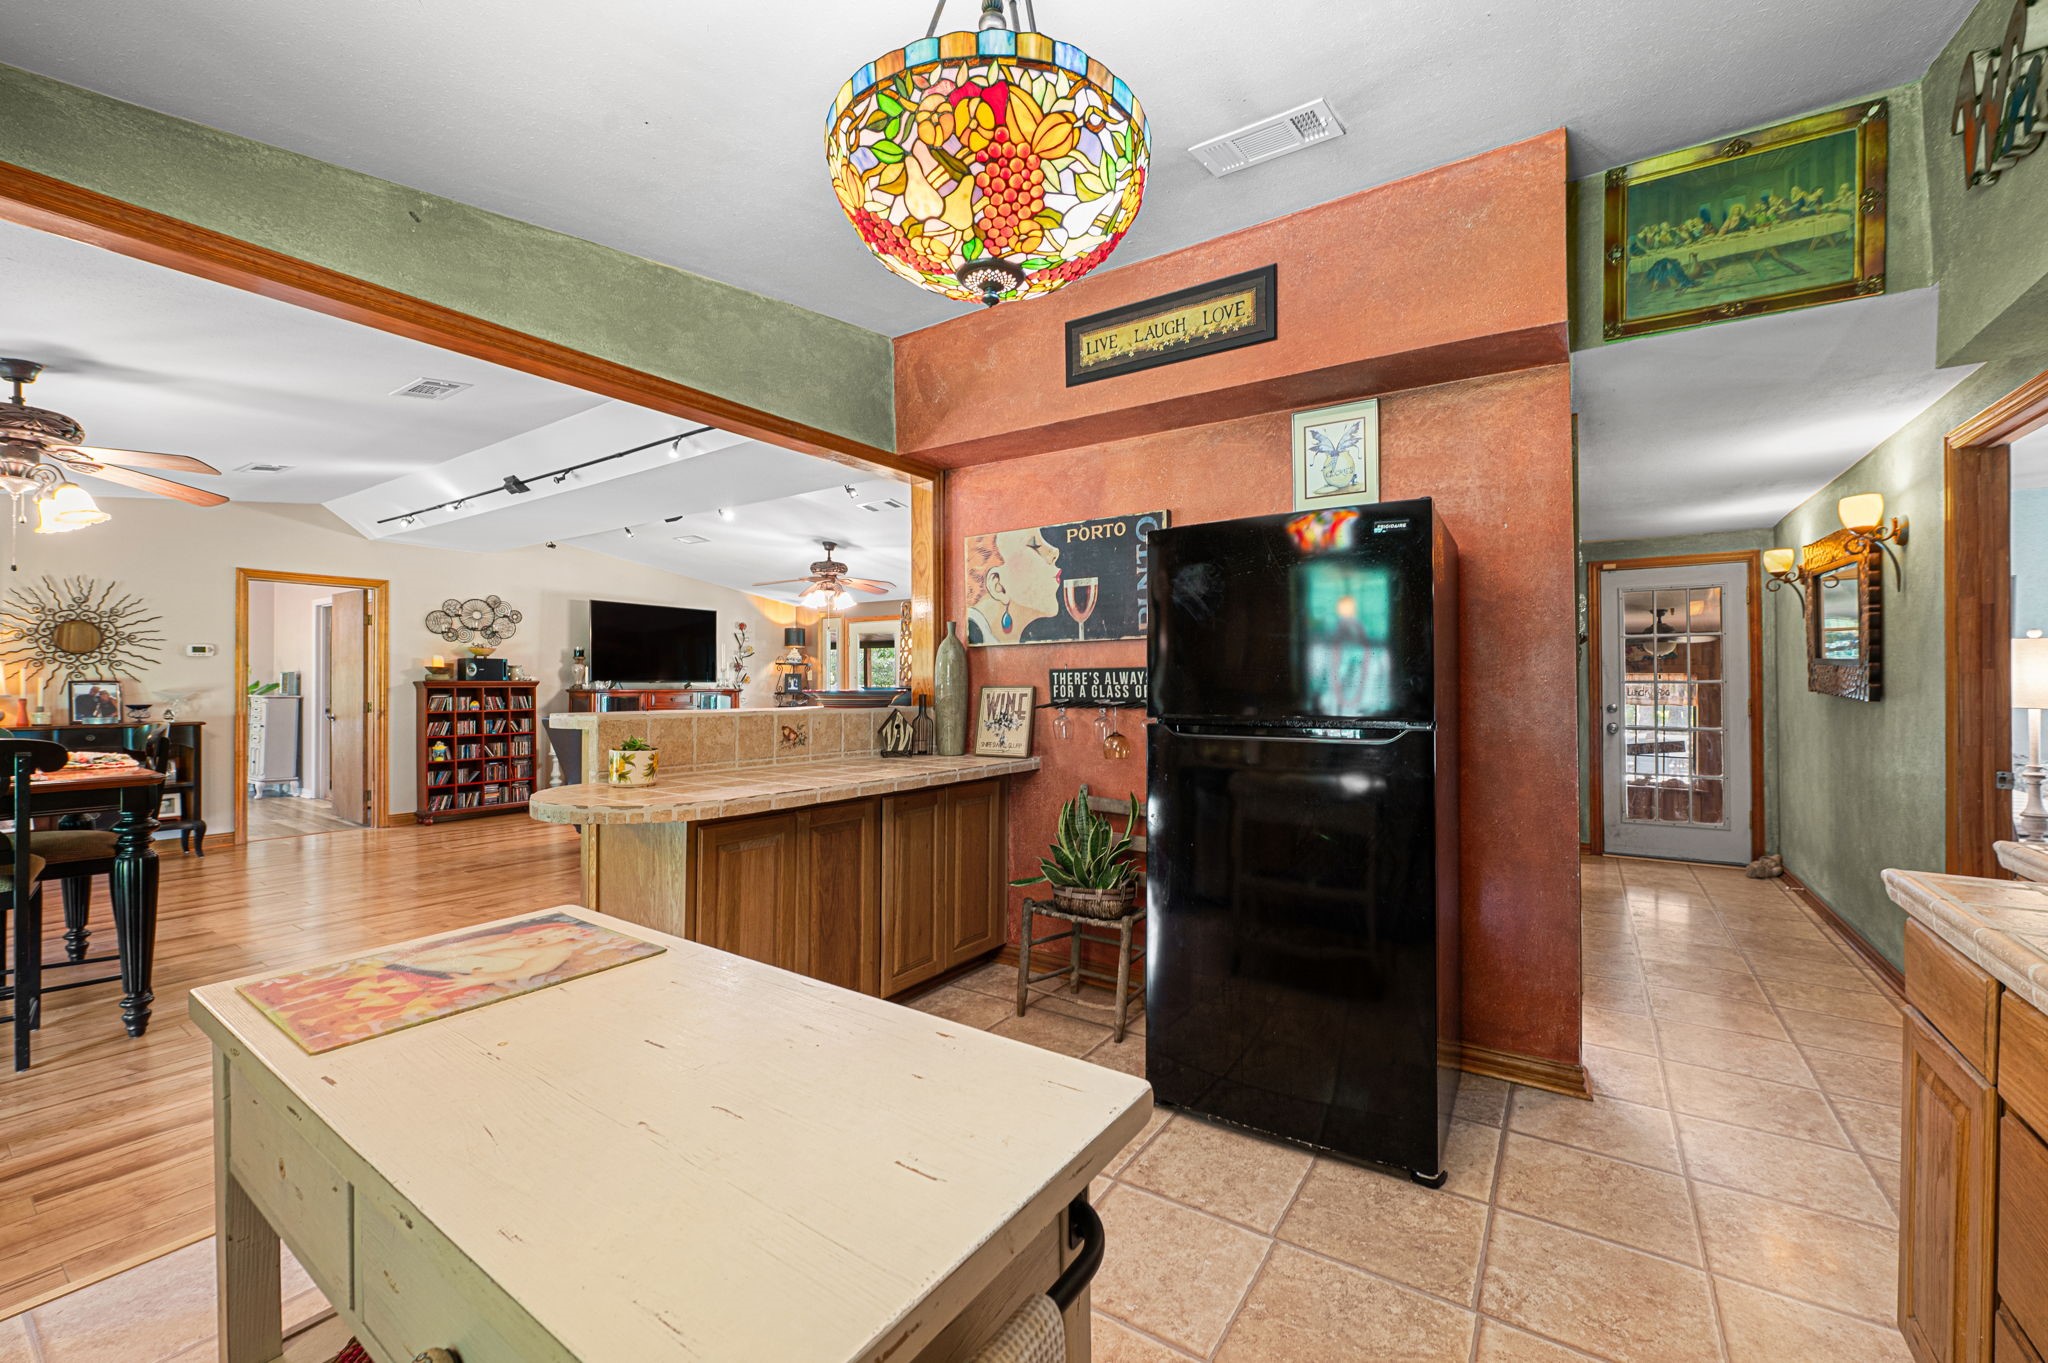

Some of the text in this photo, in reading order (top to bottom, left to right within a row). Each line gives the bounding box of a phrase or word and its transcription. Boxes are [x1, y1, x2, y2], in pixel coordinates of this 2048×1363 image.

[1086, 300, 1246, 355] LIVE LAUGH LOVE
[1066, 522, 1127, 543] PORTO
[1052, 671, 1148, 685] THERE'S ALWAY
[1053, 685, 1074, 698] FOR
[1079, 684, 1086, 698] A
[1091, 684, 1130, 698] GLASS
[986, 691, 1028, 721] WINE
